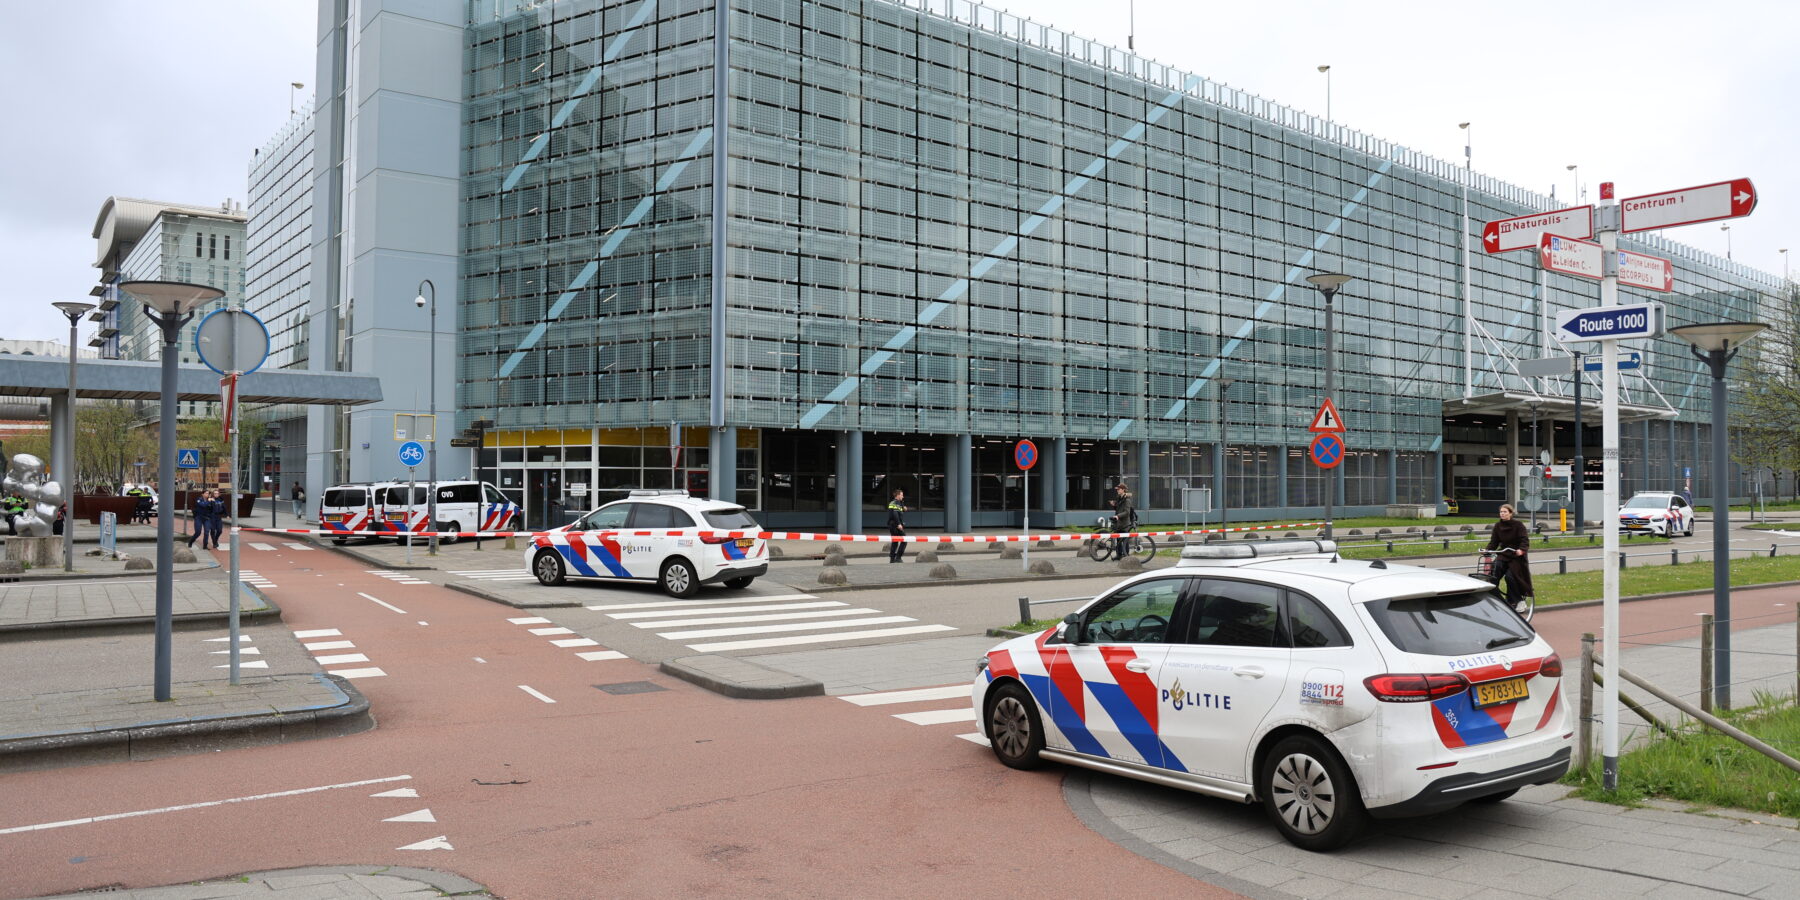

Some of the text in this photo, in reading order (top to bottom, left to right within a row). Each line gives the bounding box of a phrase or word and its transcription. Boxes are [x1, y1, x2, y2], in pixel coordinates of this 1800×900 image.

[1625, 196, 1676, 212] Centrum
[1513, 215, 1561, 230] Naturalis
[1560, 241, 1577, 253] LUMC
[1560, 258, 1580, 270] Leiden
[1644, 260, 1660, 270] Leiden
[1626, 270, 1650, 282] CORPUS
[1580, 313, 1645, 333] Route 1000
[623, 545, 652, 555] POLITIE
[1448, 655, 1496, 670] POLITIE
[1302, 682, 1323, 691] 0900
[1323, 684, 1344, 698] 112
[1481, 681, 1523, 702] S-783-XJ
[1162, 689, 1232, 711] POLITIE
[1301, 690, 1322, 698] 8844
[1445, 708, 1459, 729] 3521
